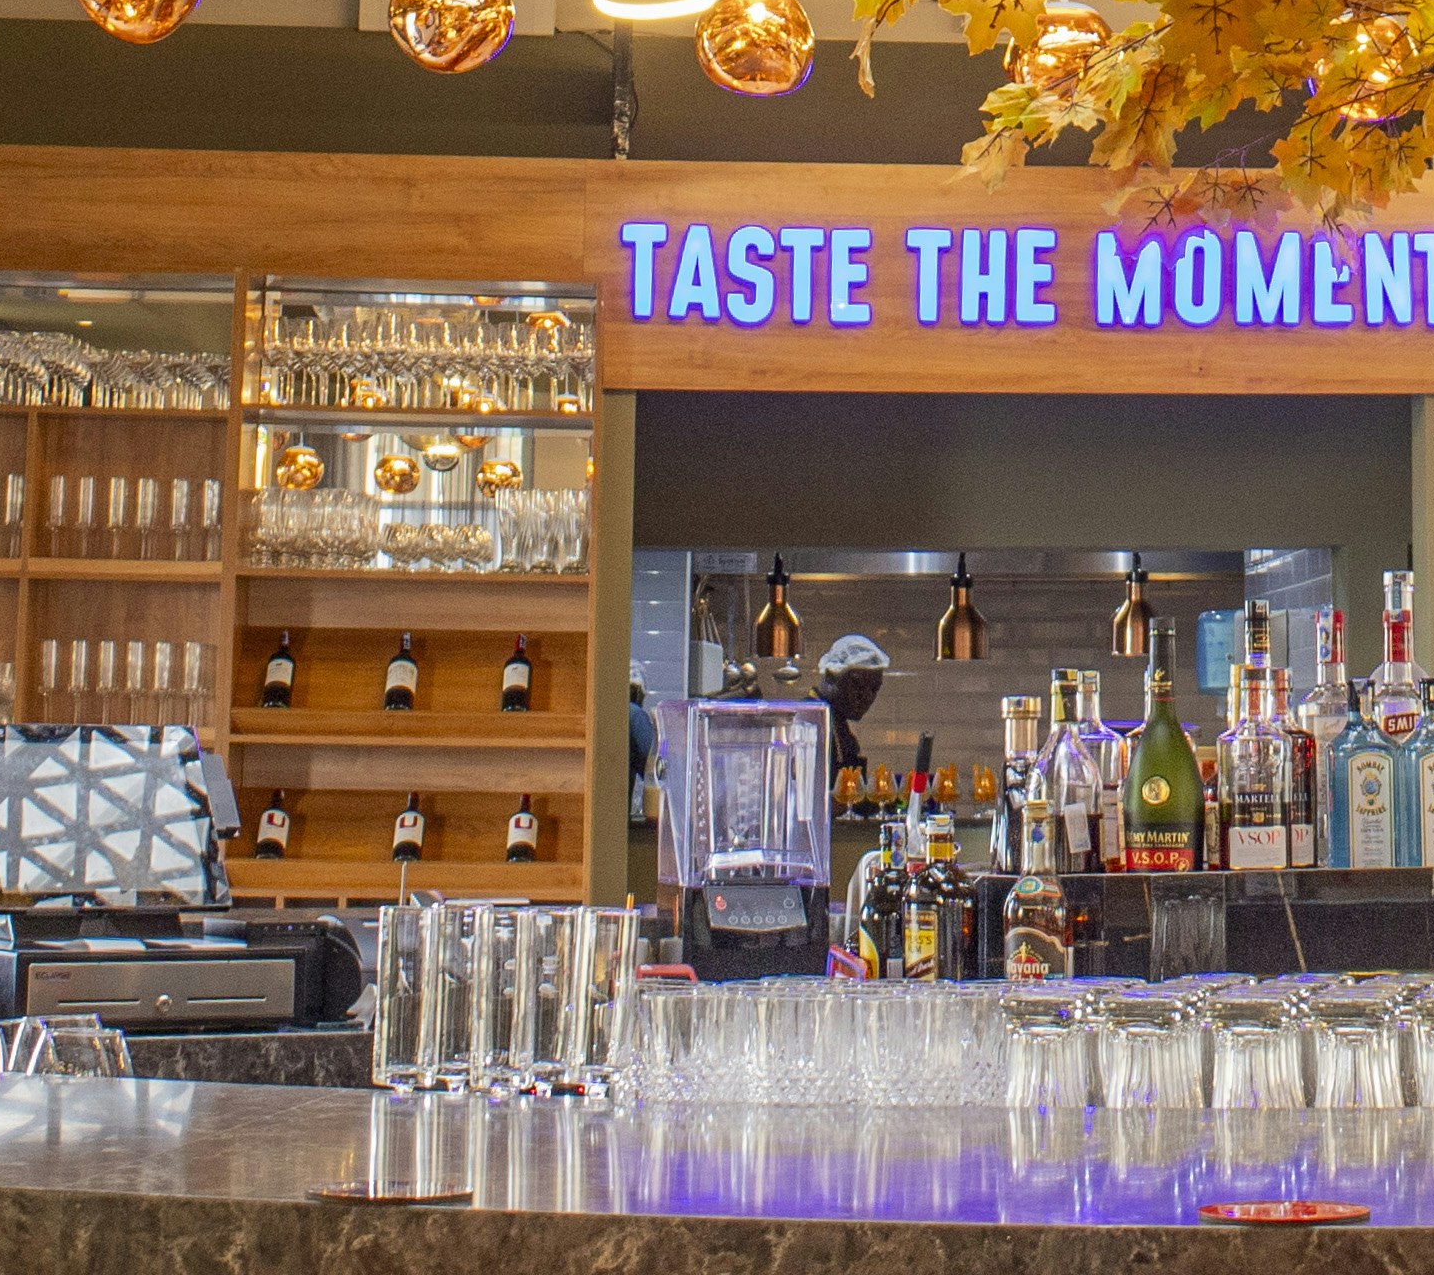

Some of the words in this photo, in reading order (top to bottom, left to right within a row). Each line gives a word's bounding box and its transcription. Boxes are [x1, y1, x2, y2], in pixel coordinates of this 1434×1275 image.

[620, 221, 874, 327] TASTE
[905, 227, 1057, 328] THE
[1387, 715, 1414, 733] SMI
[1356, 760, 1385, 774] BOMBAY
[1146, 829, 1190, 843] MARTIN
[1236, 829, 1281, 846] VSOP
